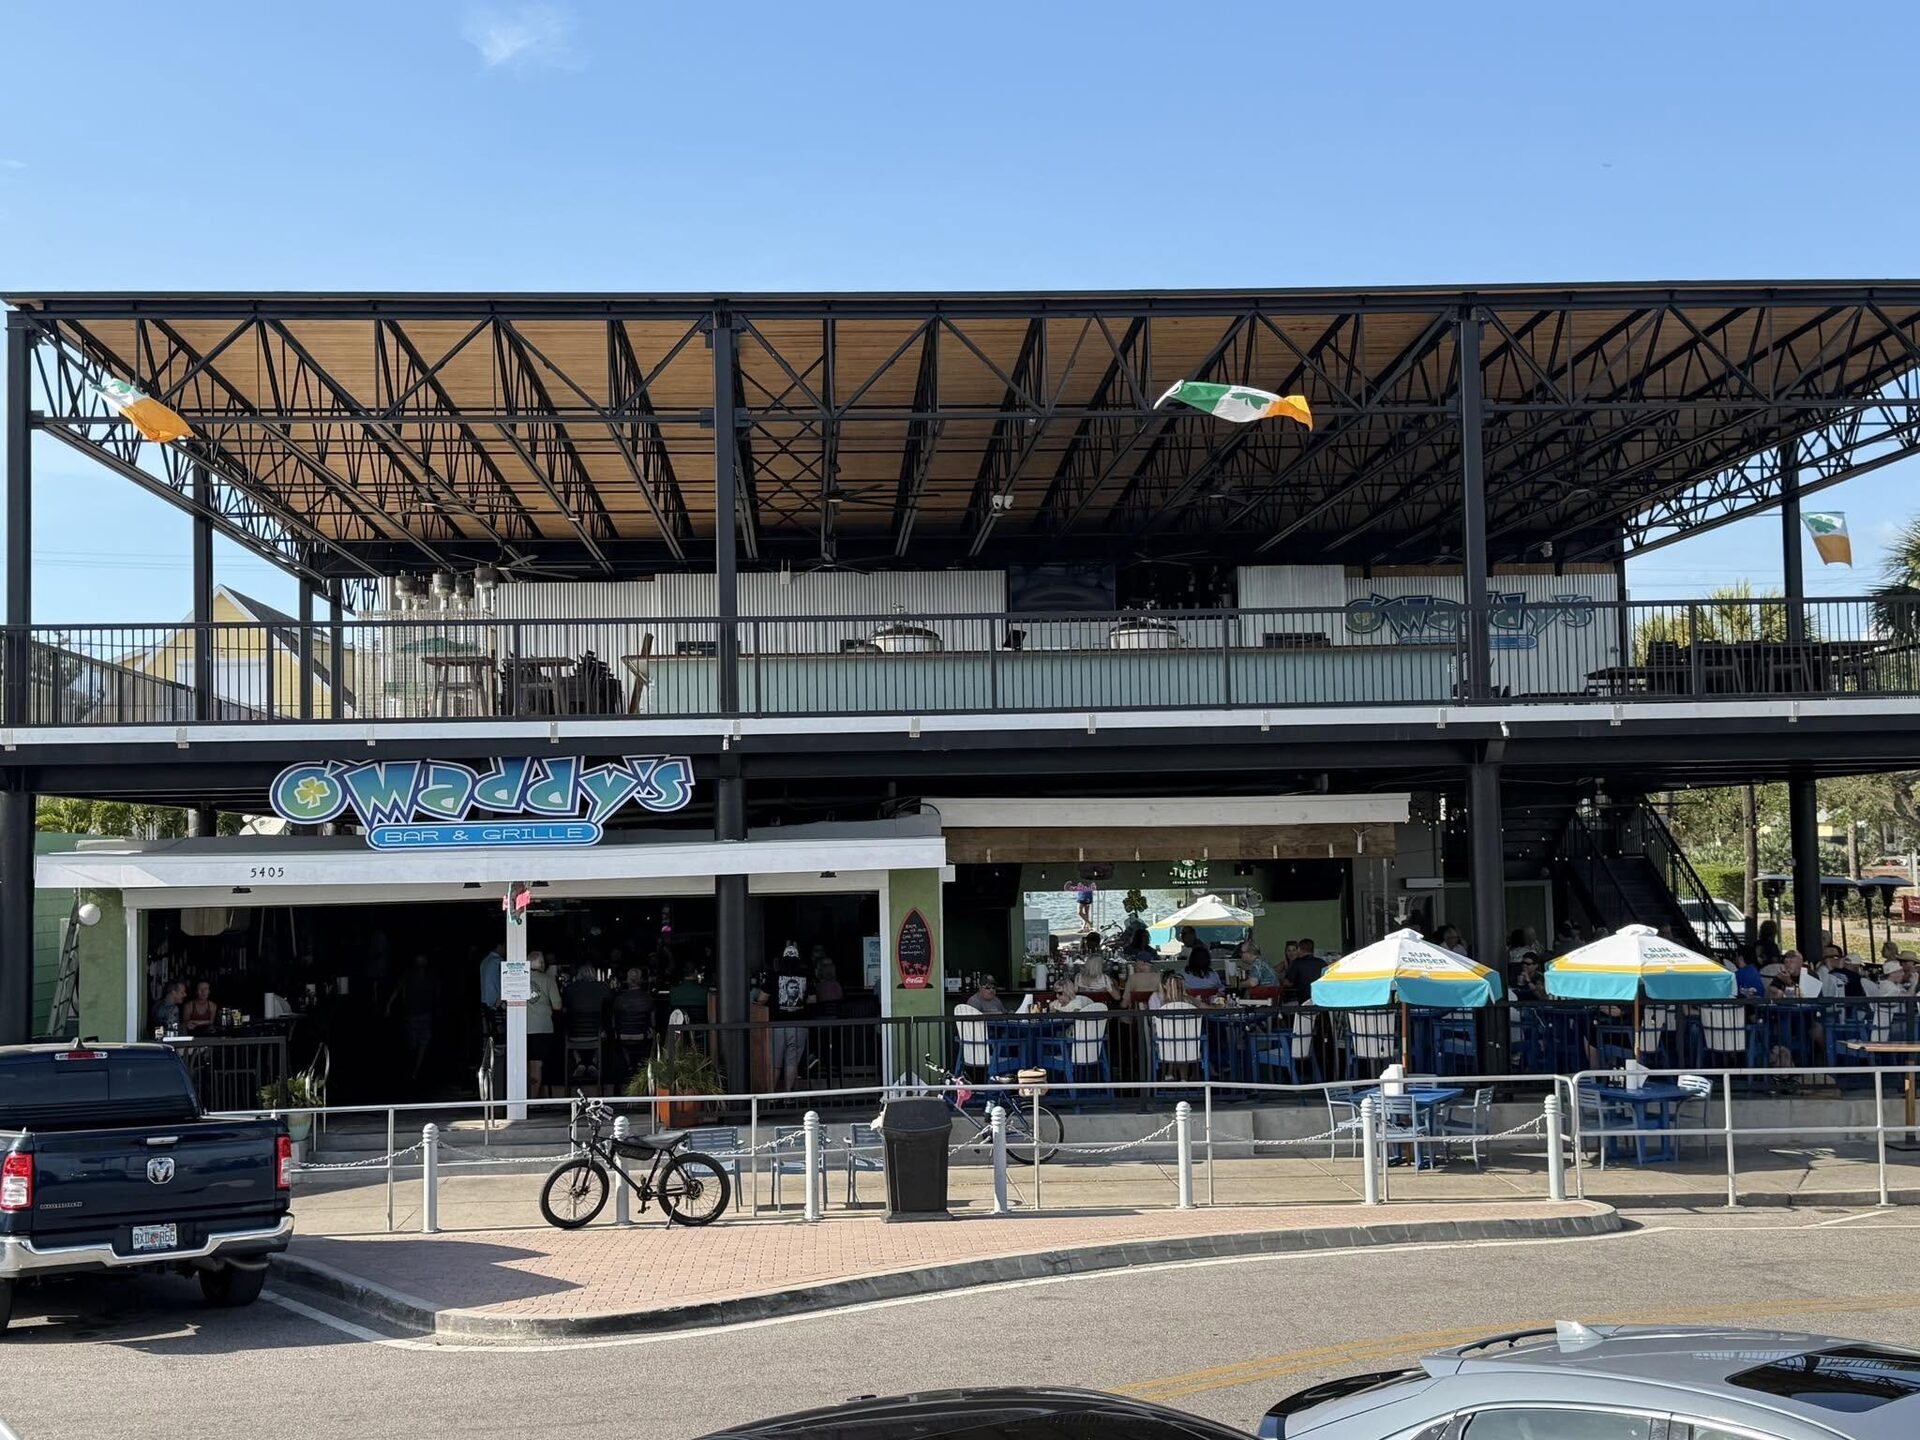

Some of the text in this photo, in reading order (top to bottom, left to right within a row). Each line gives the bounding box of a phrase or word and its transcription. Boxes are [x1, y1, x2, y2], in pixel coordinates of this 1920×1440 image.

[270, 755, 695, 826] O'Maddy's
[385, 827, 584, 842] BAR & GRILLE
[250, 867, 284, 878] 5405
[1172, 867, 1208, 879] TWELVE
[1402, 957, 1449, 965] CRUISER
